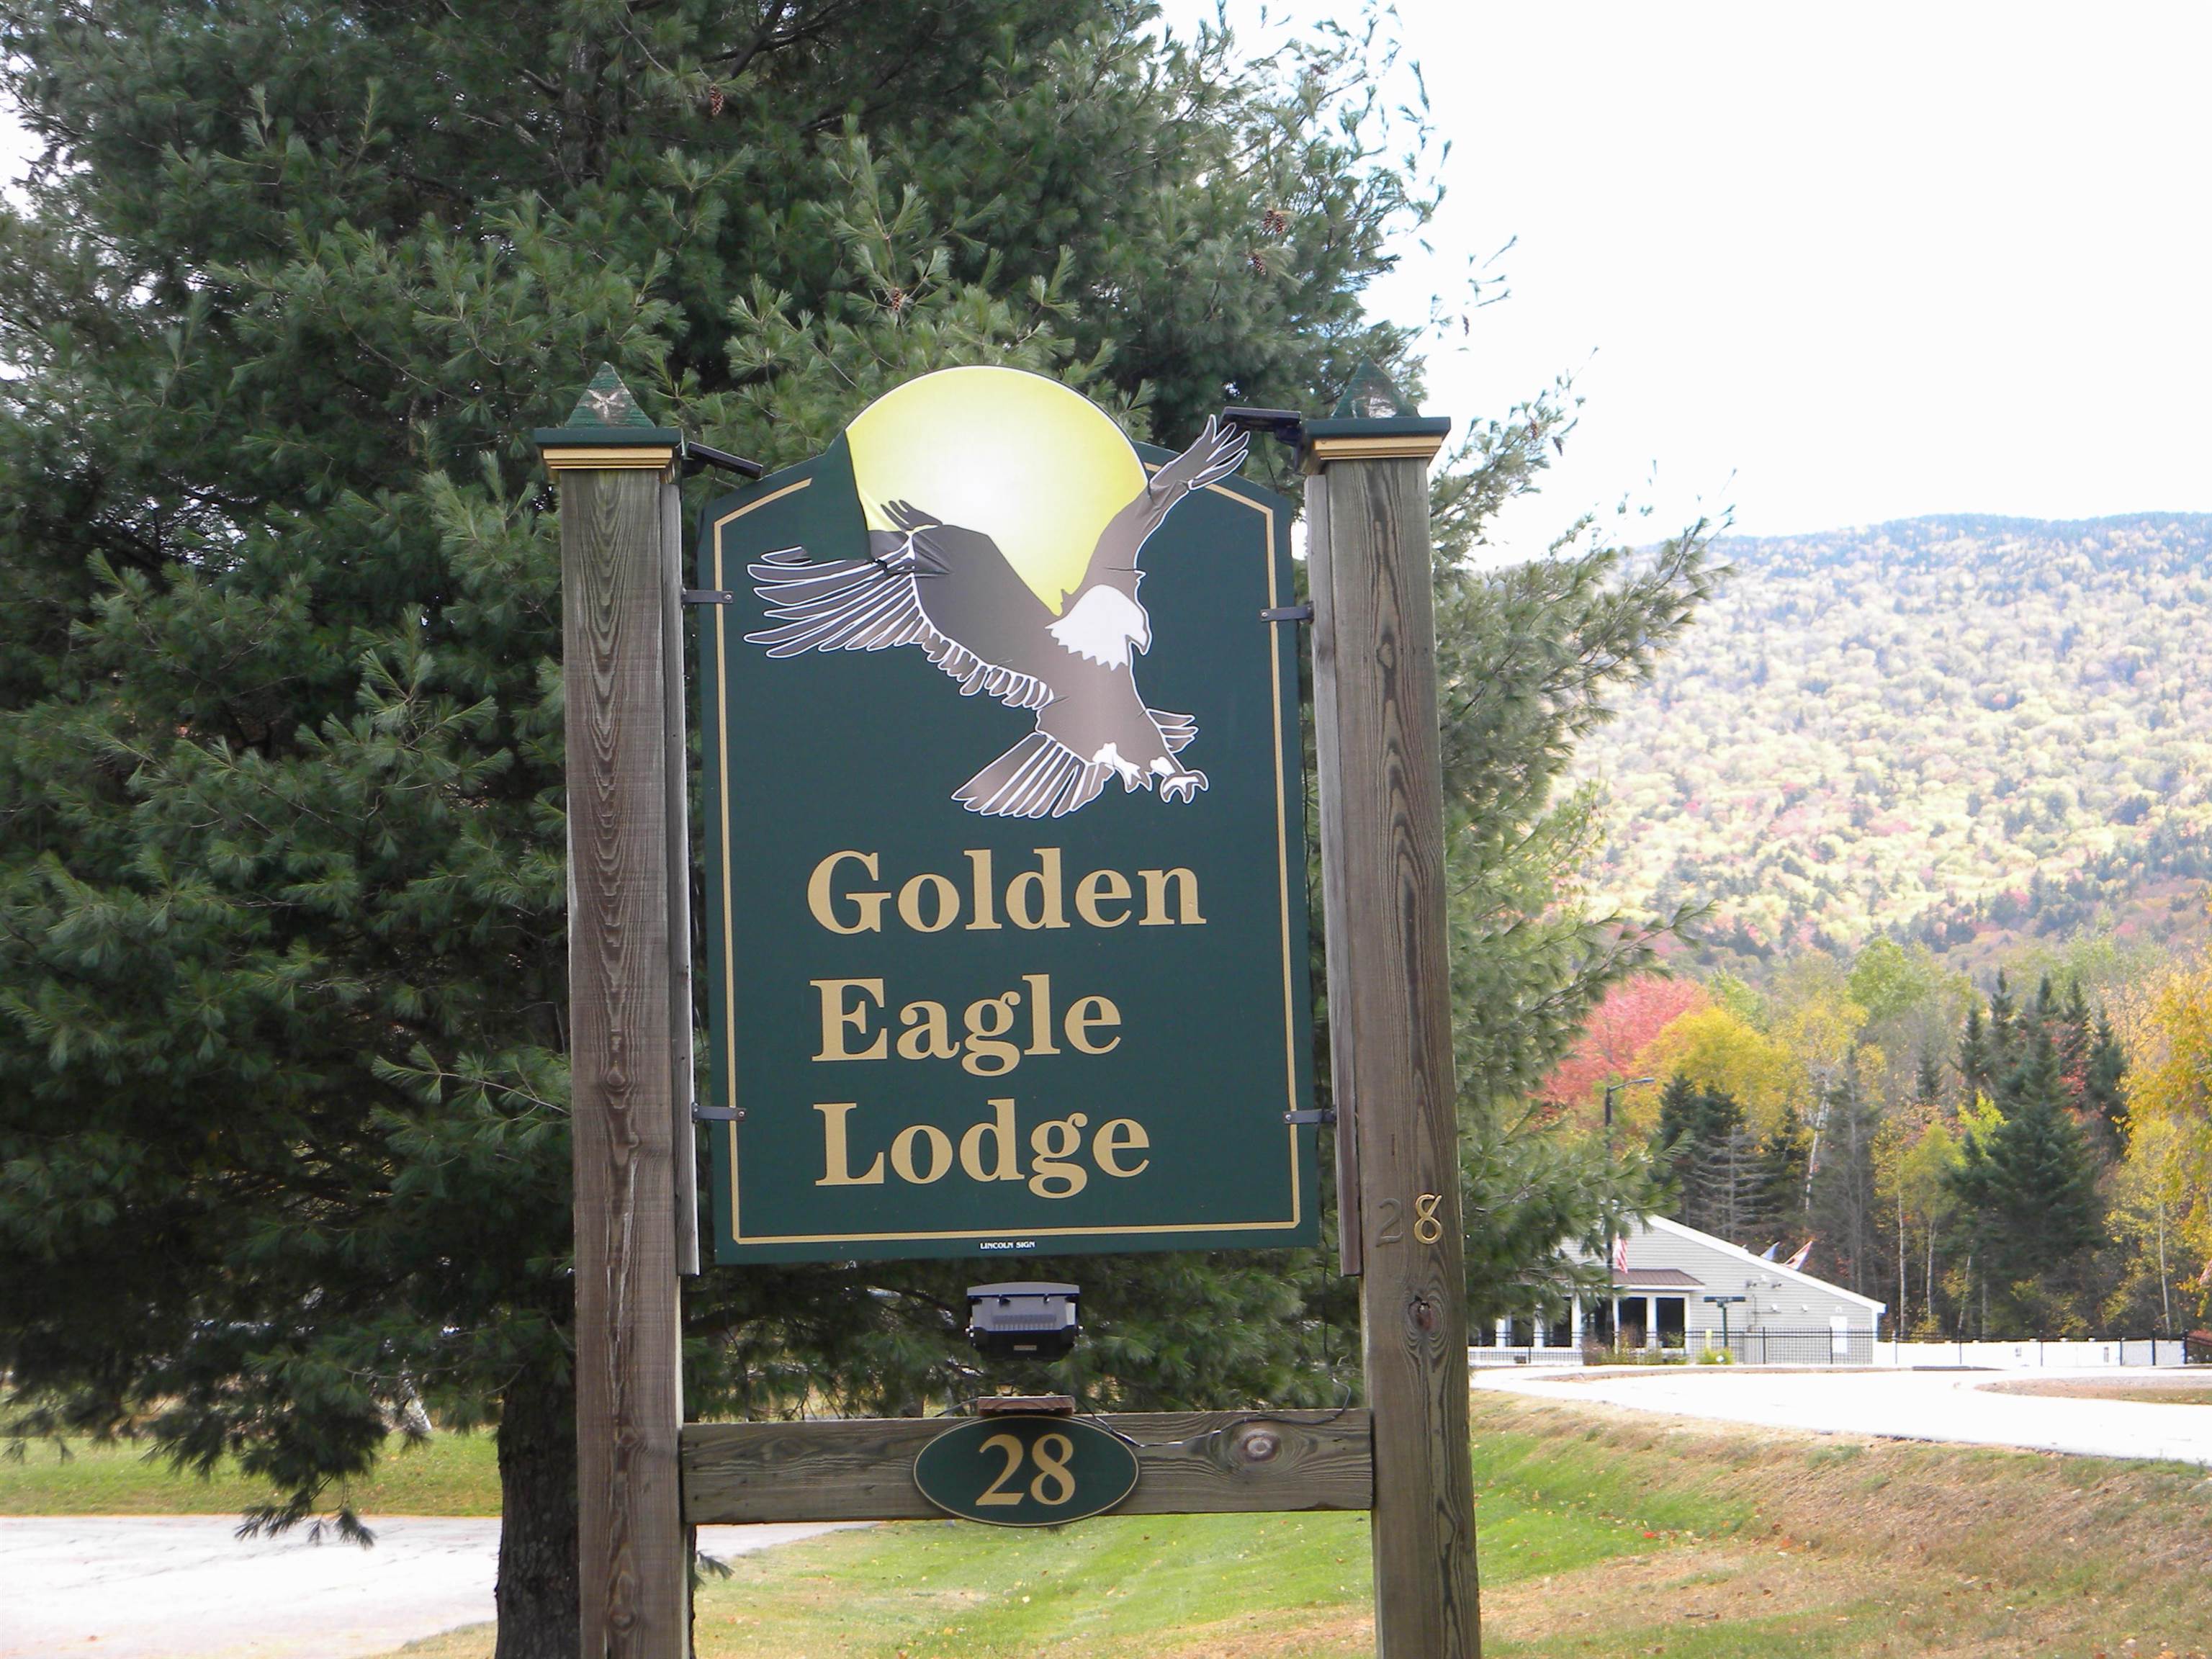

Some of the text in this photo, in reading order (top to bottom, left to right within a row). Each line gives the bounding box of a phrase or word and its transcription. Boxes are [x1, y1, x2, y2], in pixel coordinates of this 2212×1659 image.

[807, 847, 1208, 935] Golden
[809, 974, 1122, 1076] Eagle
[813, 1098, 1151, 1199] Lodge
[1377, 1194, 1442, 1246] 28
[976, 1434, 1076, 1506] 28
